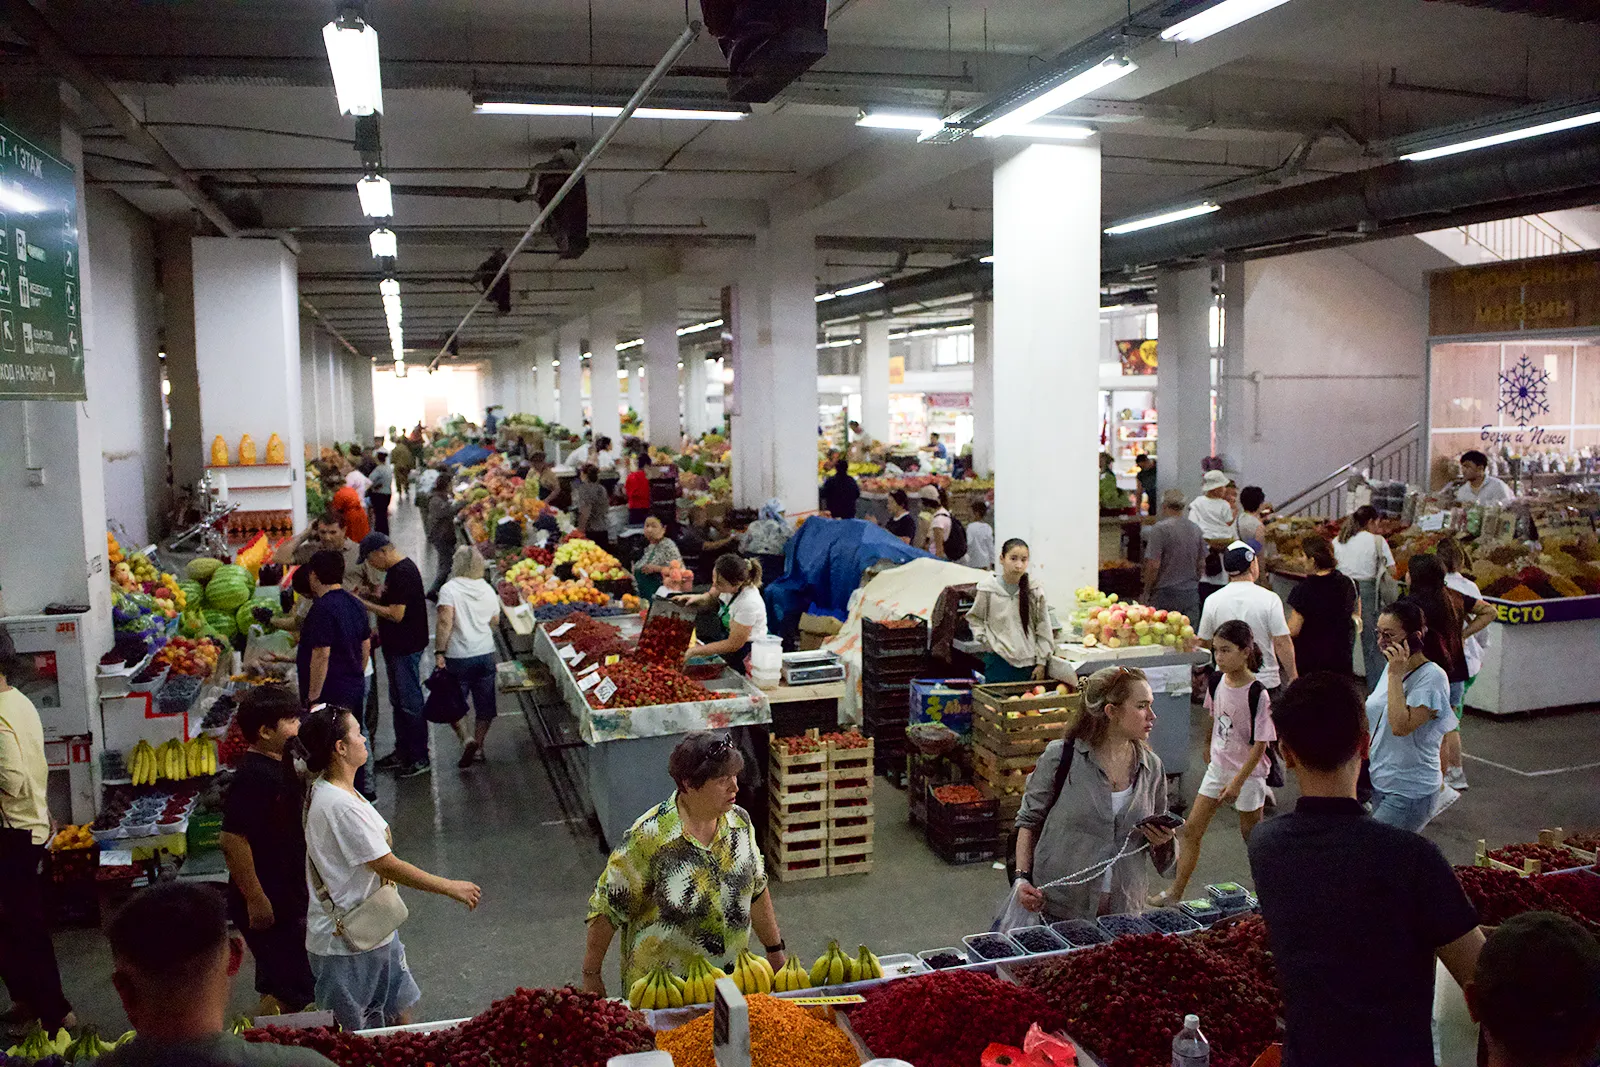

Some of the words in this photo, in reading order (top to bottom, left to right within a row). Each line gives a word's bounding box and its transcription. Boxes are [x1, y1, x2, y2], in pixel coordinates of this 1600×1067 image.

[20, 148, 43, 179] ЭТАЖ
[15, 365, 25, 381] НА
[1515, 433, 1523, 443] и
[1529, 426, 1566, 445] Пеки
[1491, 604, 1545, 623] ЕСТО
